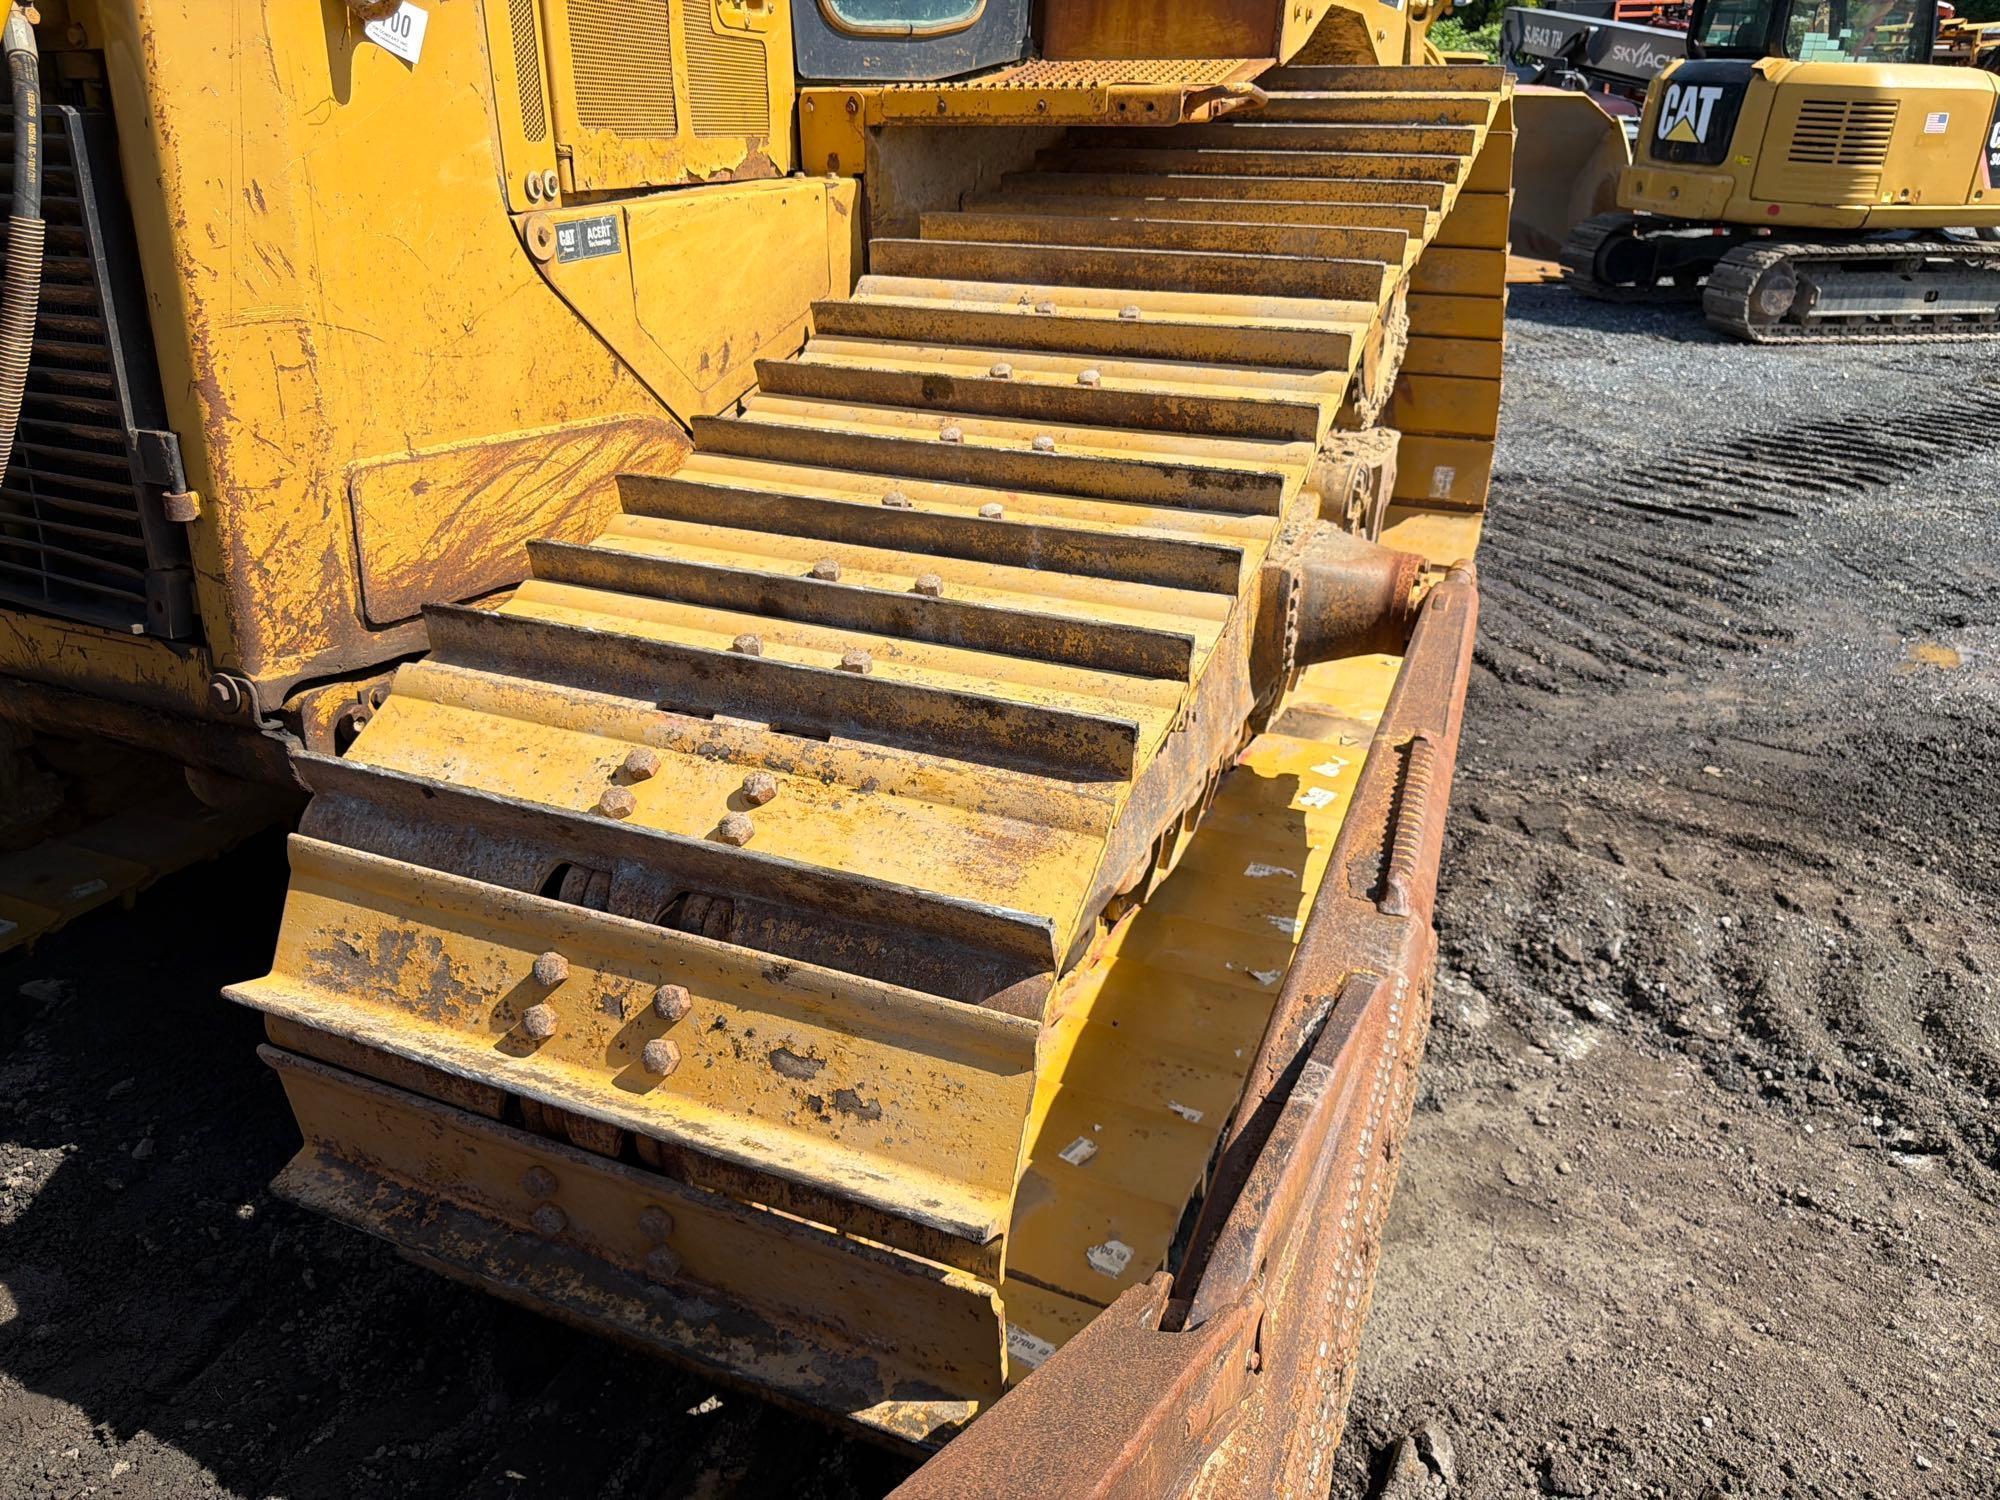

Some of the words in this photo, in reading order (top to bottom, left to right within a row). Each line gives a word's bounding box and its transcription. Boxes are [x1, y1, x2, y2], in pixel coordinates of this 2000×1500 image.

[382, 10, 411, 38] 00
[1550, 30, 1564, 49] TH
[1658, 83, 1723, 143] CAT
[559, 229, 575, 246] CAT
[587, 225, 611, 240] ACERT
